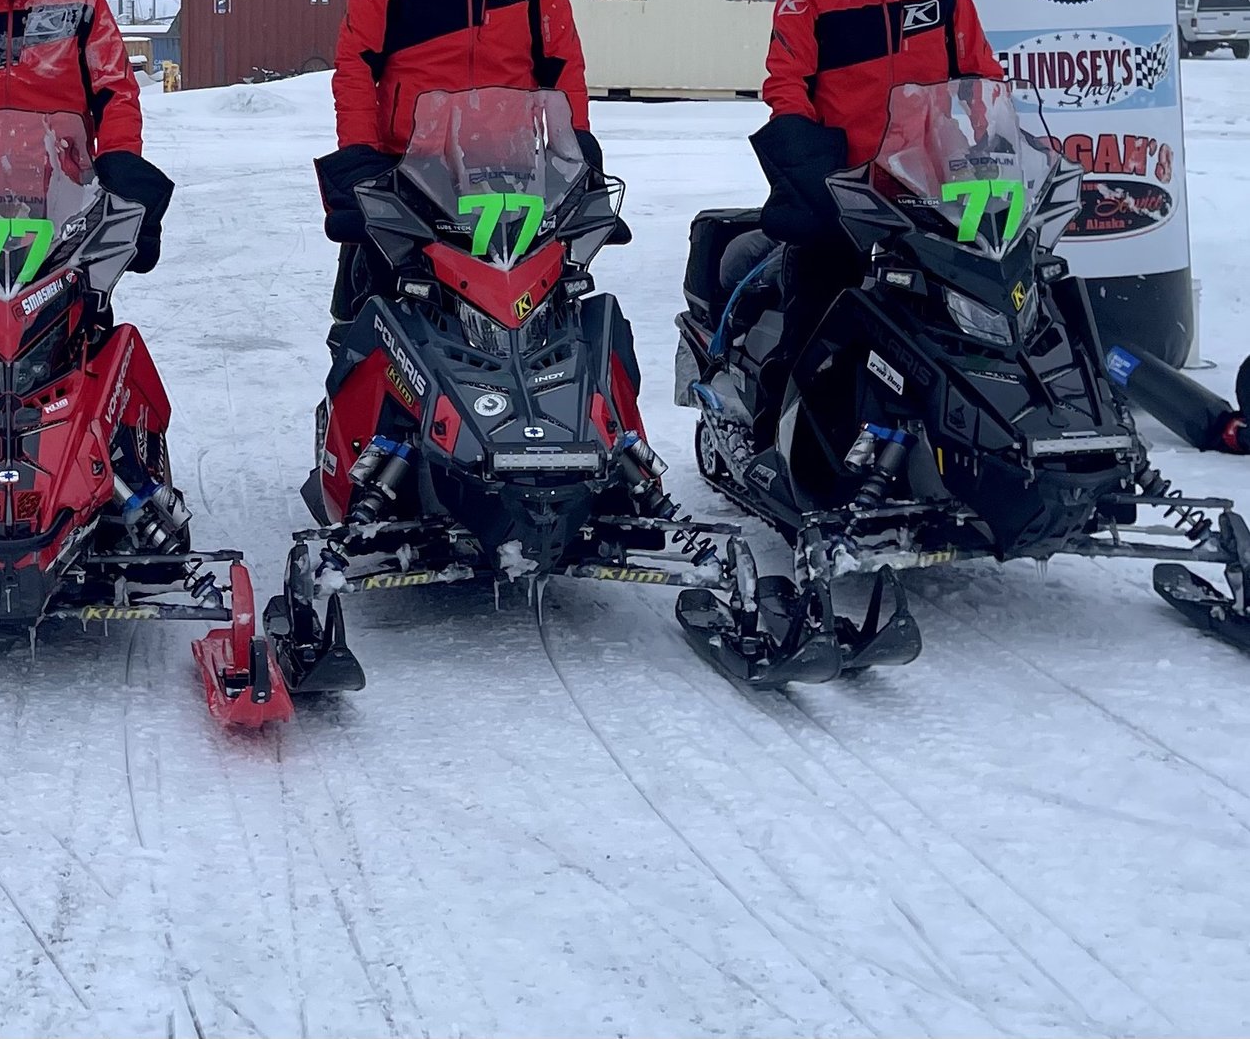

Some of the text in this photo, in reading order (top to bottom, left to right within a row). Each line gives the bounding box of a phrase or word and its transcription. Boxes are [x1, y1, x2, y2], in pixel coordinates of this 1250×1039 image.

[1013, 49, 1133, 90] LINDSEY'S
[1058, 81, 1122, 104] Shop
[458, 193, 544, 256] 77
[942, 179, 1025, 242] 77
[1086, 218, 1125, 230] Alaska
[374, 314, 427, 396] POLARIS
[534, 371, 565, 383] INDY
